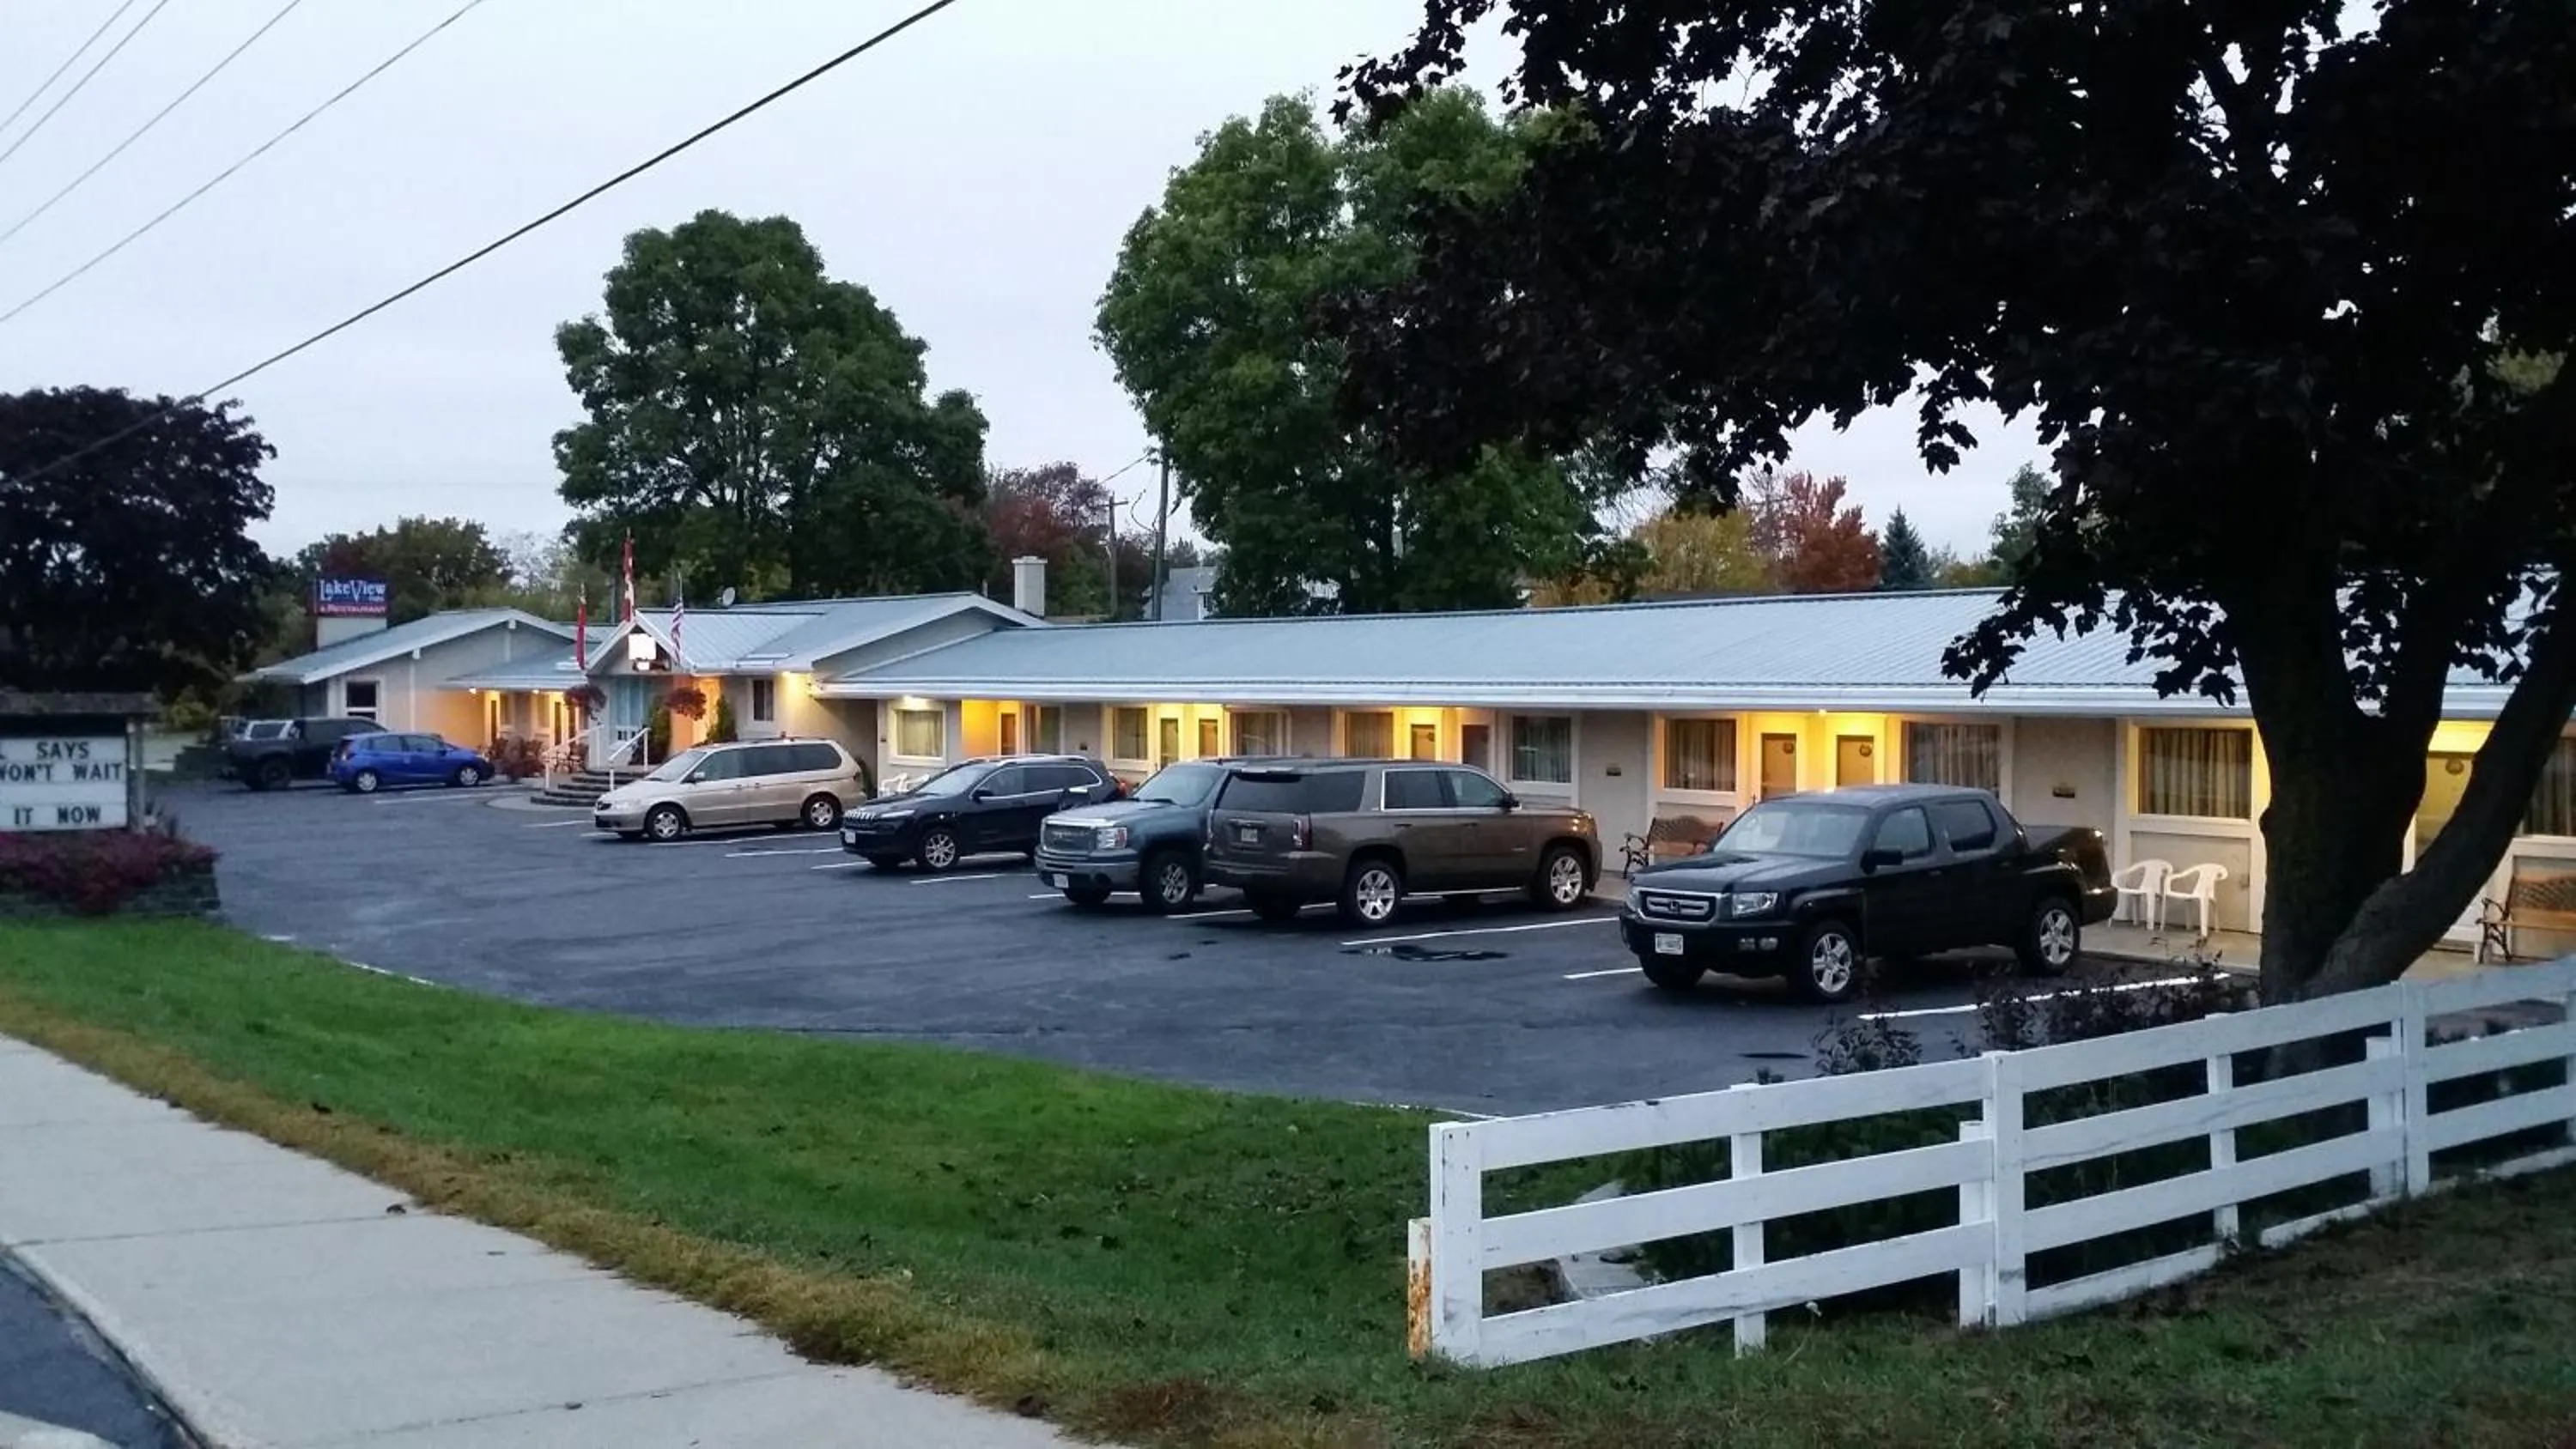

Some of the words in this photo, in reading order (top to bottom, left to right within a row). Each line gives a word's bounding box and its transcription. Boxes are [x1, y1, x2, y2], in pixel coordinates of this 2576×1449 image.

[36, 741, 89, 760] SAYS
[72, 762, 122, 781] WAIT
[14, 807, 33, 825] IT
[57, 805, 101, 824] NOW
